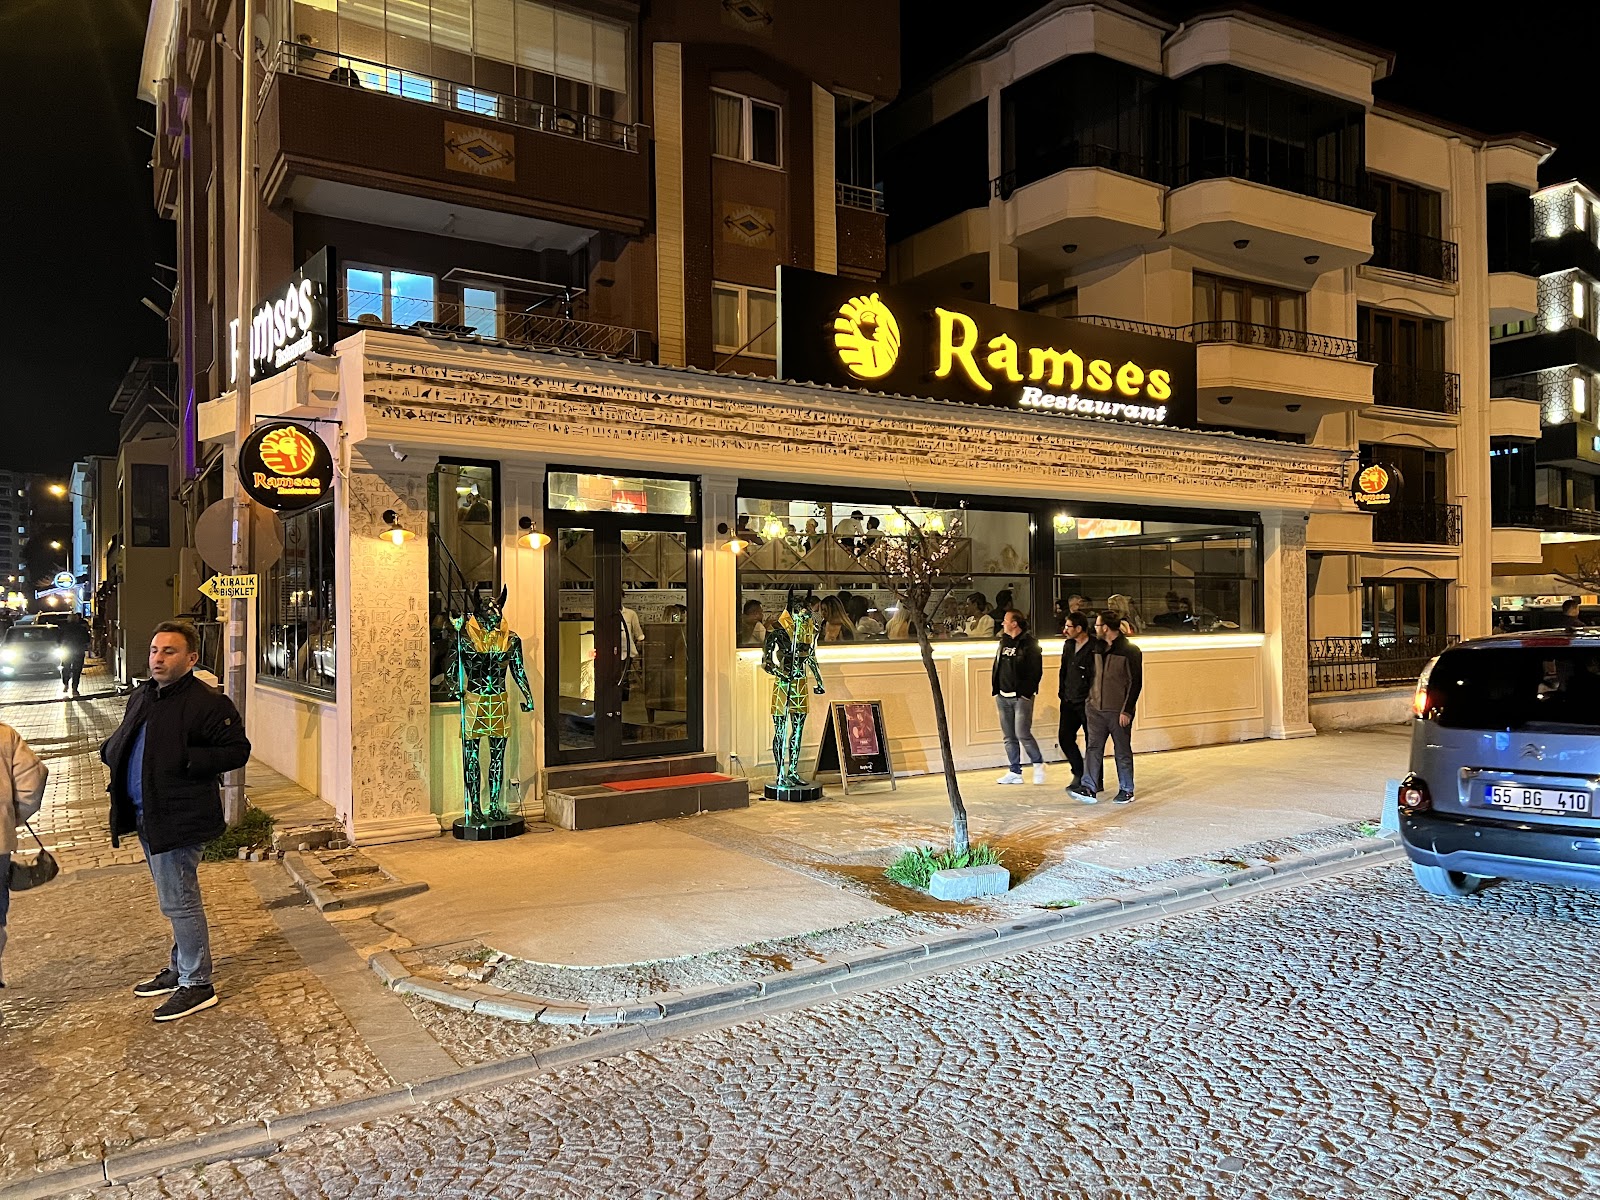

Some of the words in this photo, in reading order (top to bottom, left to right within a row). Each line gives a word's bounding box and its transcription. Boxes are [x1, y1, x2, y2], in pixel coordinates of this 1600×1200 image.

[935, 306, 1173, 400] Ramses
[1019, 386, 1167, 421] Restaurant
[253, 472, 320, 489] Ramses
[1493, 788, 1511, 804] 55
[1523, 790, 1542, 806] BG
[1558, 793, 1585, 810] 410
